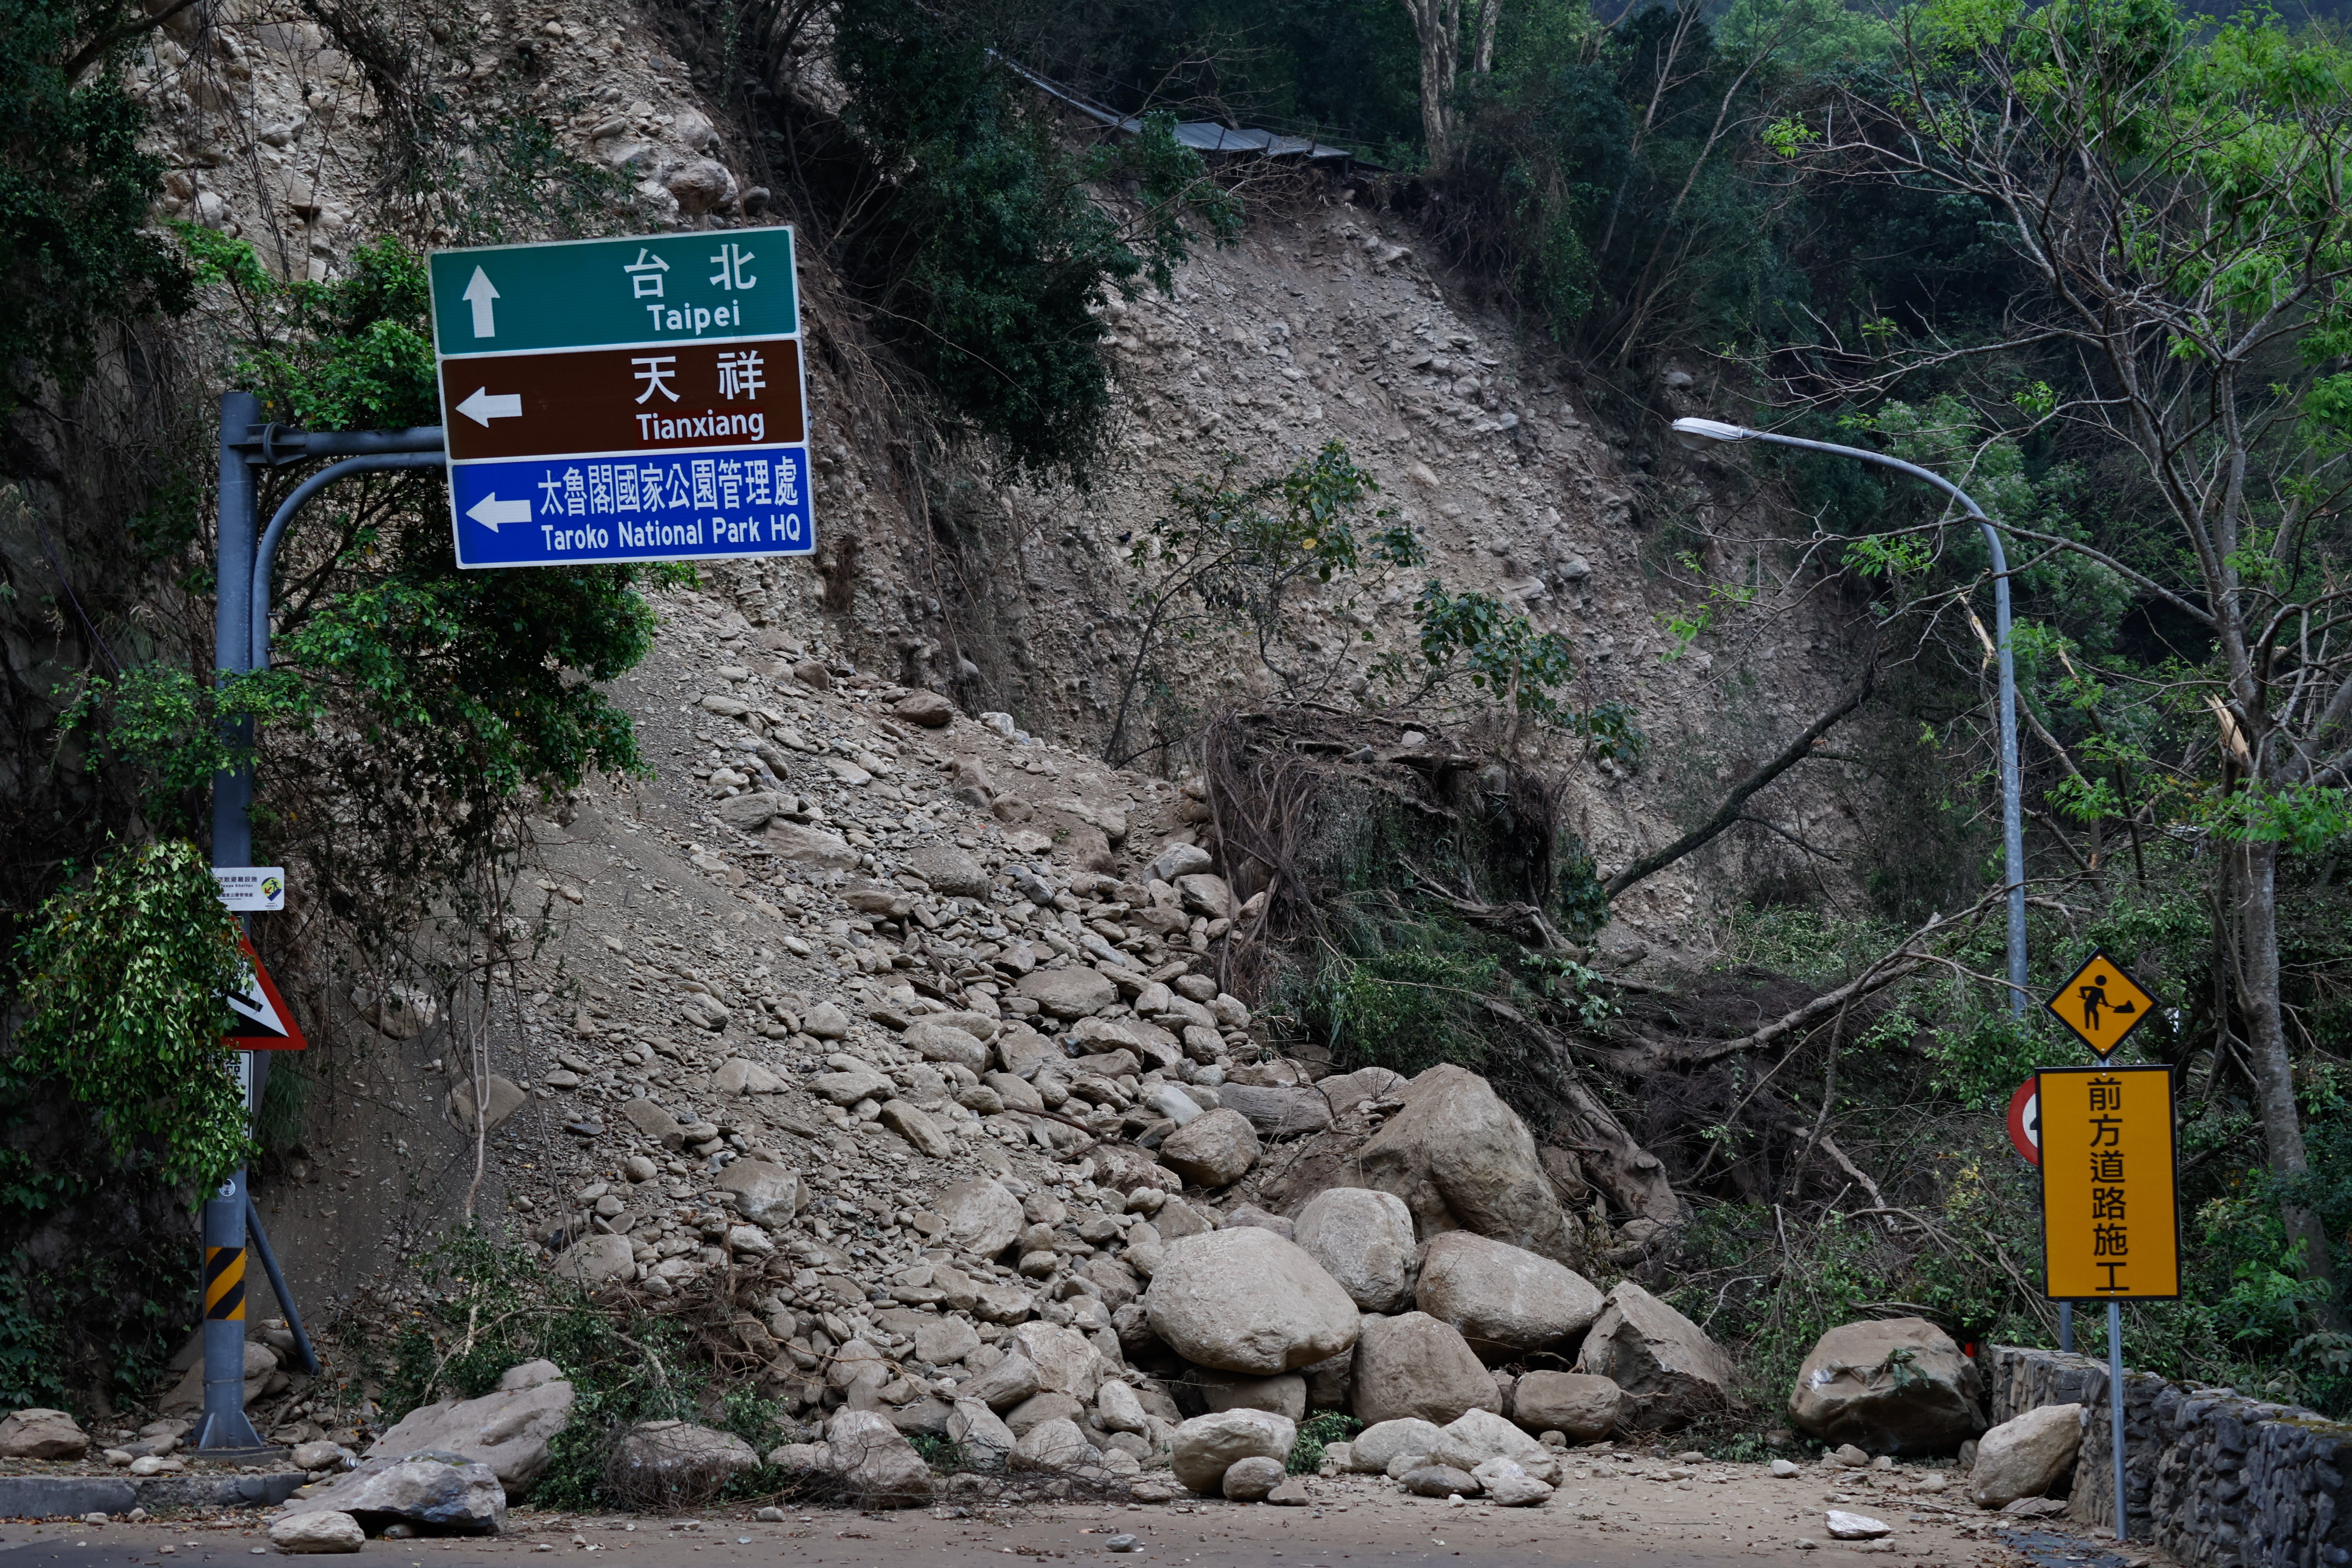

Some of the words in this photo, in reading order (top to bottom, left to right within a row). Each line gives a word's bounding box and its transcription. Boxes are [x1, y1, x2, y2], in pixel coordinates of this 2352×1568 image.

[624, 243, 757, 298] 台北
[646, 299, 740, 335] Taipei
[631, 350, 766, 405] 天祥
[636, 409, 765, 441] Tianxiang
[538, 456, 798, 516] 太魯閣國家公園管理處
[541, 523, 609, 550] Taroko
[618, 518, 703, 547] National
[712, 516, 761, 543] Park
[771, 513, 800, 542] HQ
[2087, 1077, 2130, 1291] 前方道路施工
